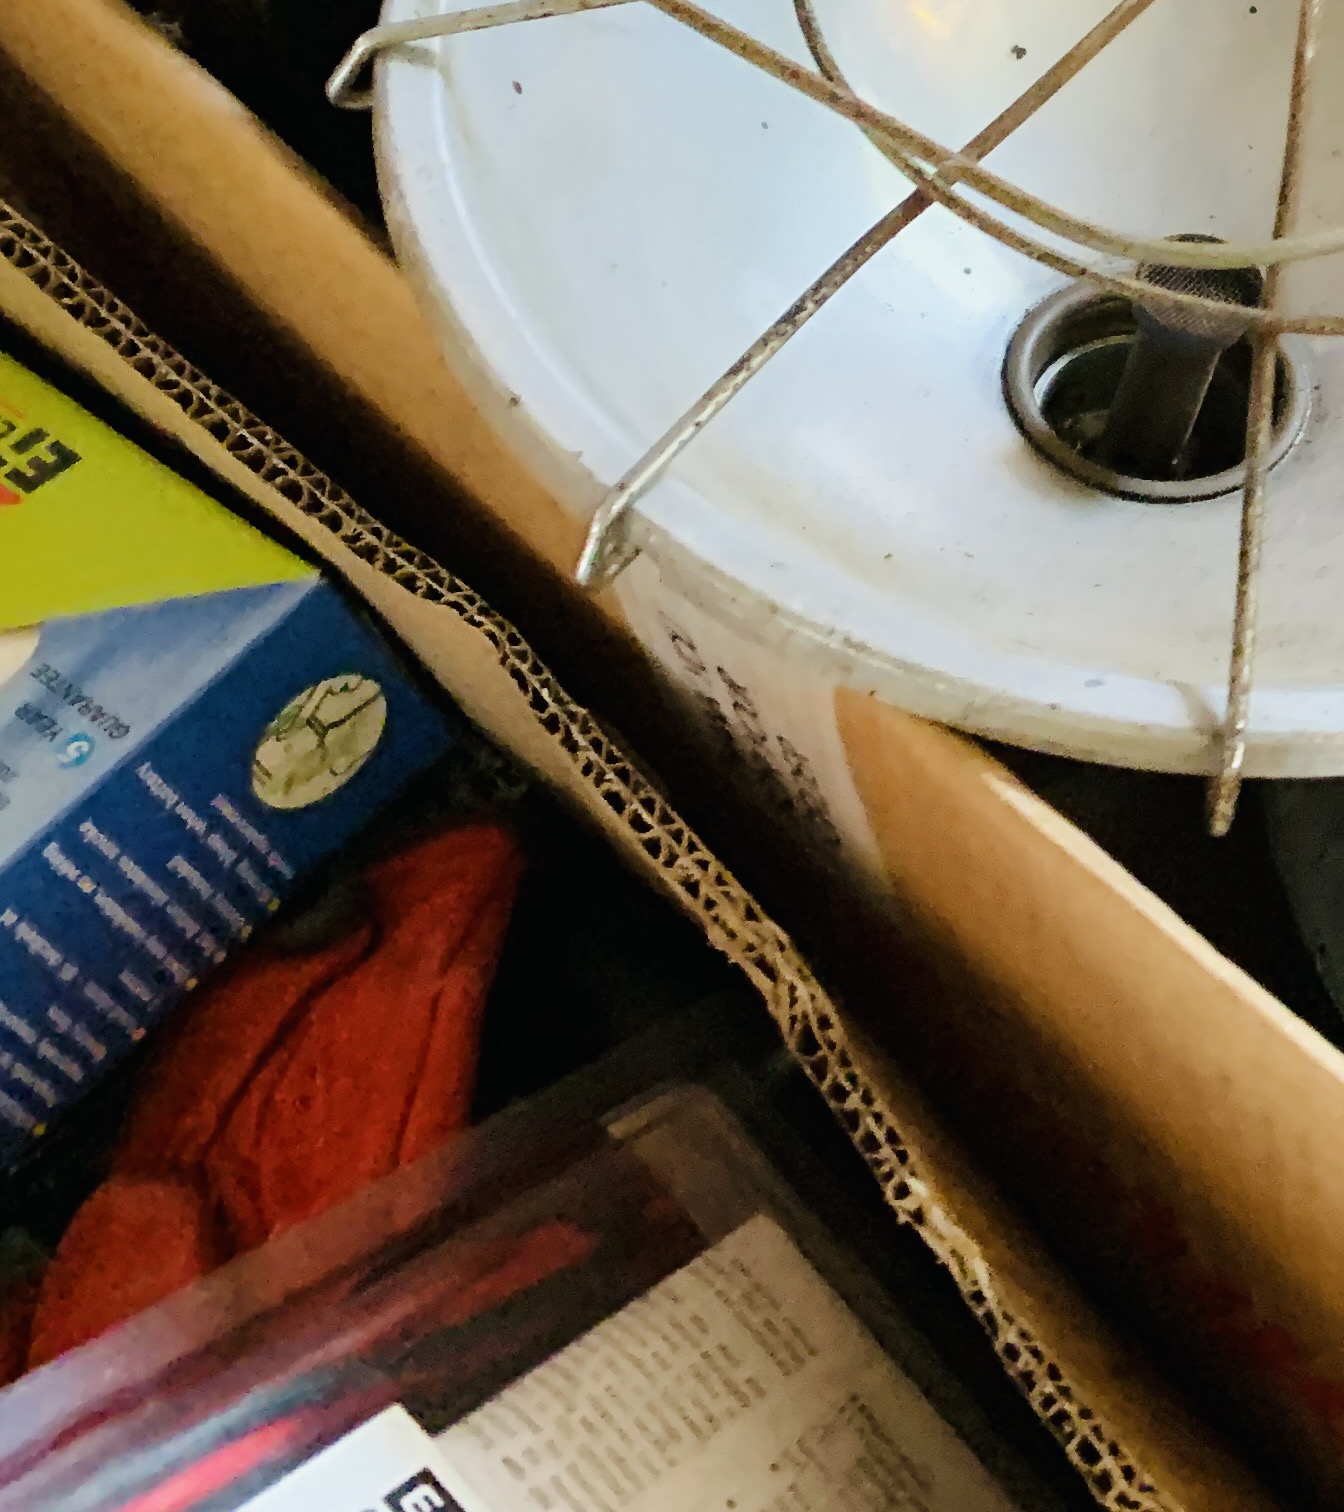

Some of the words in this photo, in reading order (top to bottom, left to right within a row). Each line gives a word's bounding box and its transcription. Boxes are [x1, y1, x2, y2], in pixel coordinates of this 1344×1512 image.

[15, 701, 63, 742] YEAR
[30, 663, 131, 740] GUARANTEE
[56, 739, 90, 764] 5
